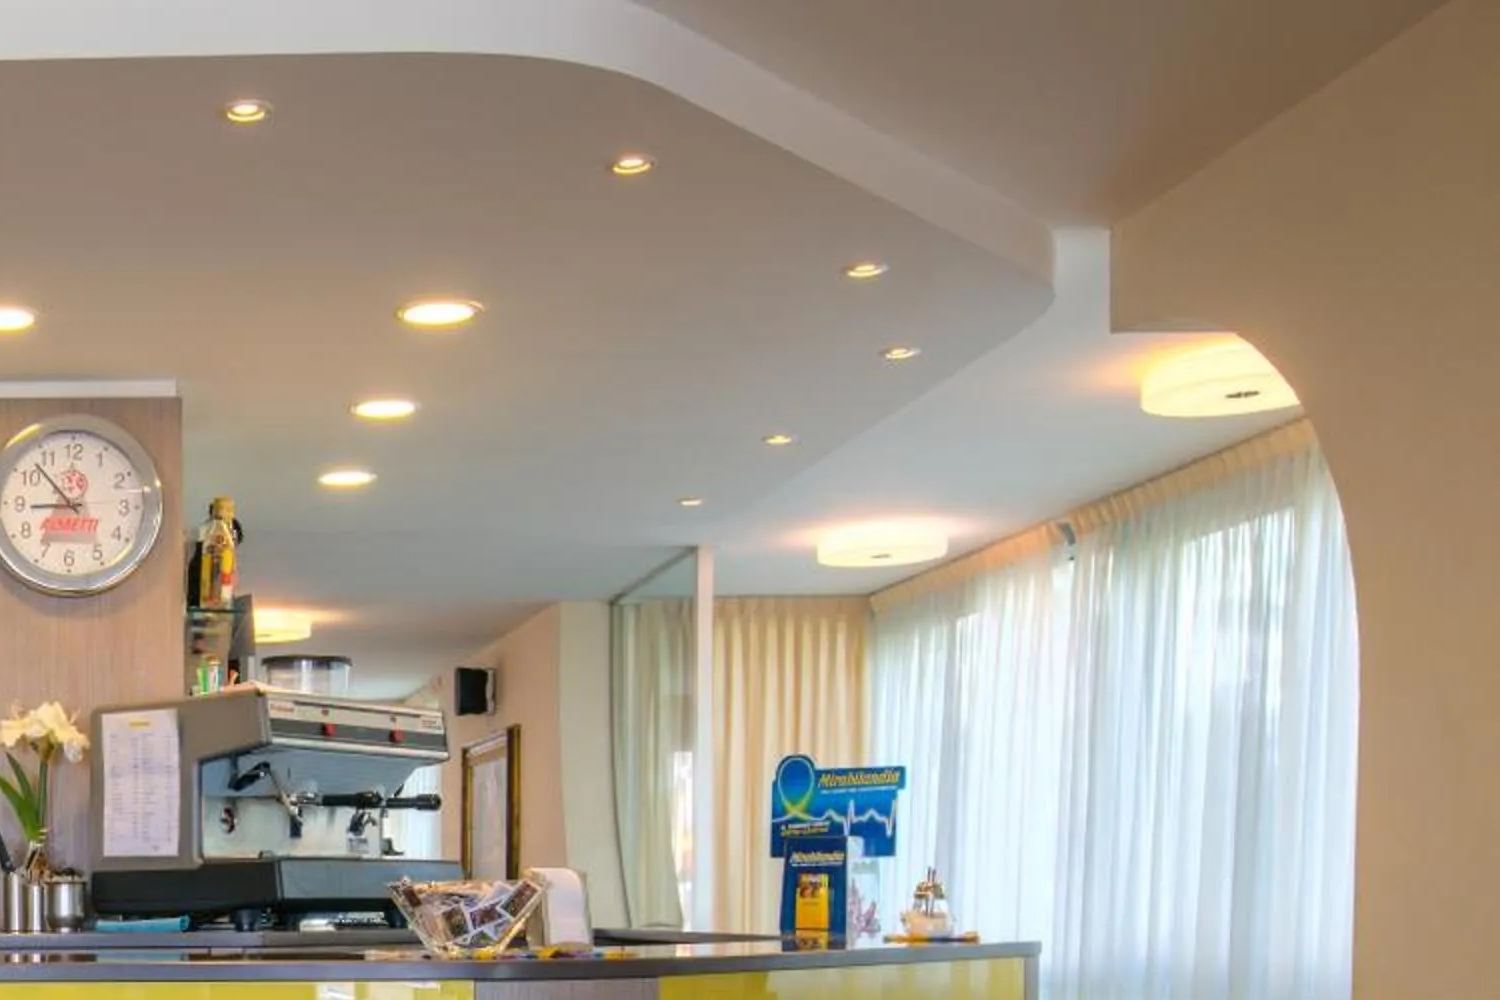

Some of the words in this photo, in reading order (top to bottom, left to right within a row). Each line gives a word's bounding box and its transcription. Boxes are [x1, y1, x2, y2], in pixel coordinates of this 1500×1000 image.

[41, 451, 56, 467] 11
[64, 443, 84, 461] 12
[96, 452, 104, 468] 1
[21, 470, 42, 487] 10
[113, 472, 126, 490] 2
[14, 496, 26, 512] 9
[118, 499, 130, 516] 3
[20, 522, 32, 539] 8
[110, 525, 122, 541] 4
[41, 544, 51, 559] 7
[63, 550, 75, 567] 6
[91, 543, 103, 560] 5
